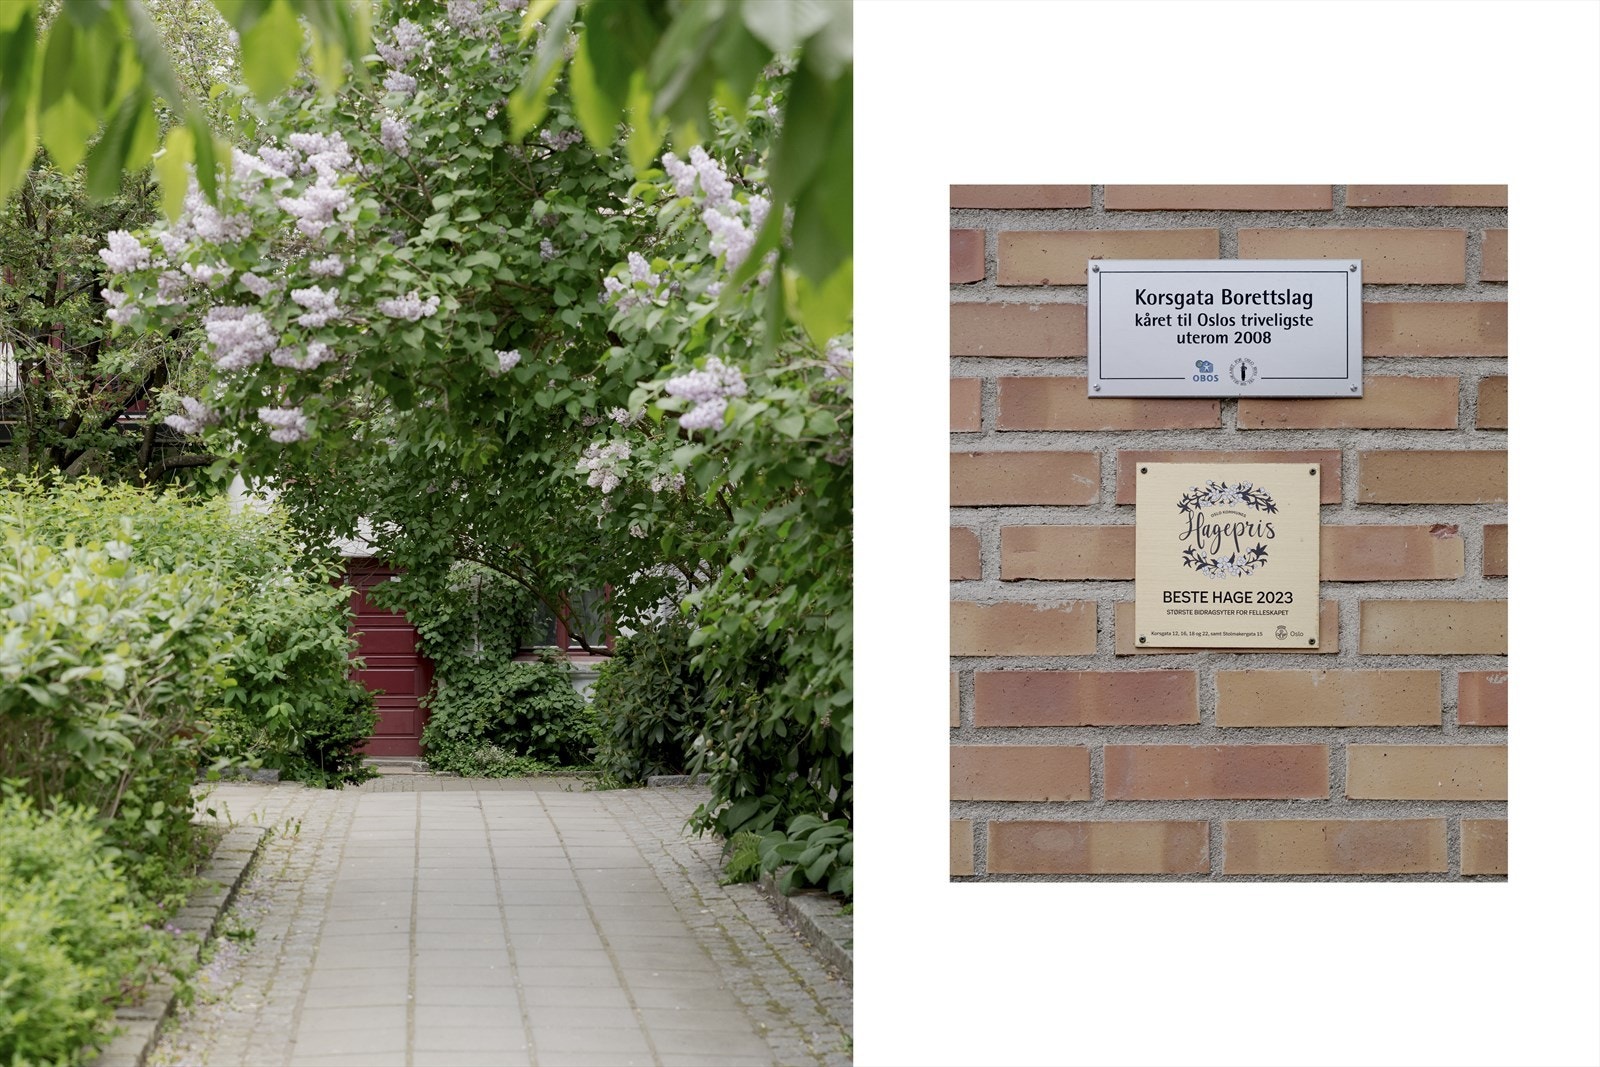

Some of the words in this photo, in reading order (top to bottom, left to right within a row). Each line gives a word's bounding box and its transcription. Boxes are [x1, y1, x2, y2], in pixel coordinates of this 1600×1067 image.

[1135, 288, 1214, 310] Korsgata
[1221, 288, 1313, 310] Borettslag
[1135, 312, 1173, 327] kåret
[1177, 312, 1192, 327] til
[1197, 312, 1236, 327] Oslos
[1241, 312, 1314, 330] triveligste
[1176, 331, 1229, 345] uterom
[1233, 330, 1272, 345] 2008
[1192, 374, 1219, 382] OBOS
[1210, 510, 1222, 518] OSLO
[1179, 510, 1276, 555] Hagepris
[1162, 590, 1209, 604] BESTE
[1212, 590, 1254, 604] HAGE
[1256, 590, 1294, 605] 2023
[1166, 608, 1193, 616] STØRSTE
[1194, 608, 1235, 616] BIDRAGSYTER
[1235, 608, 1248, 616] FOR
[1248, 608, 1289, 616] FELLESKAPET
[1289, 630, 1304, 638] Oslo
